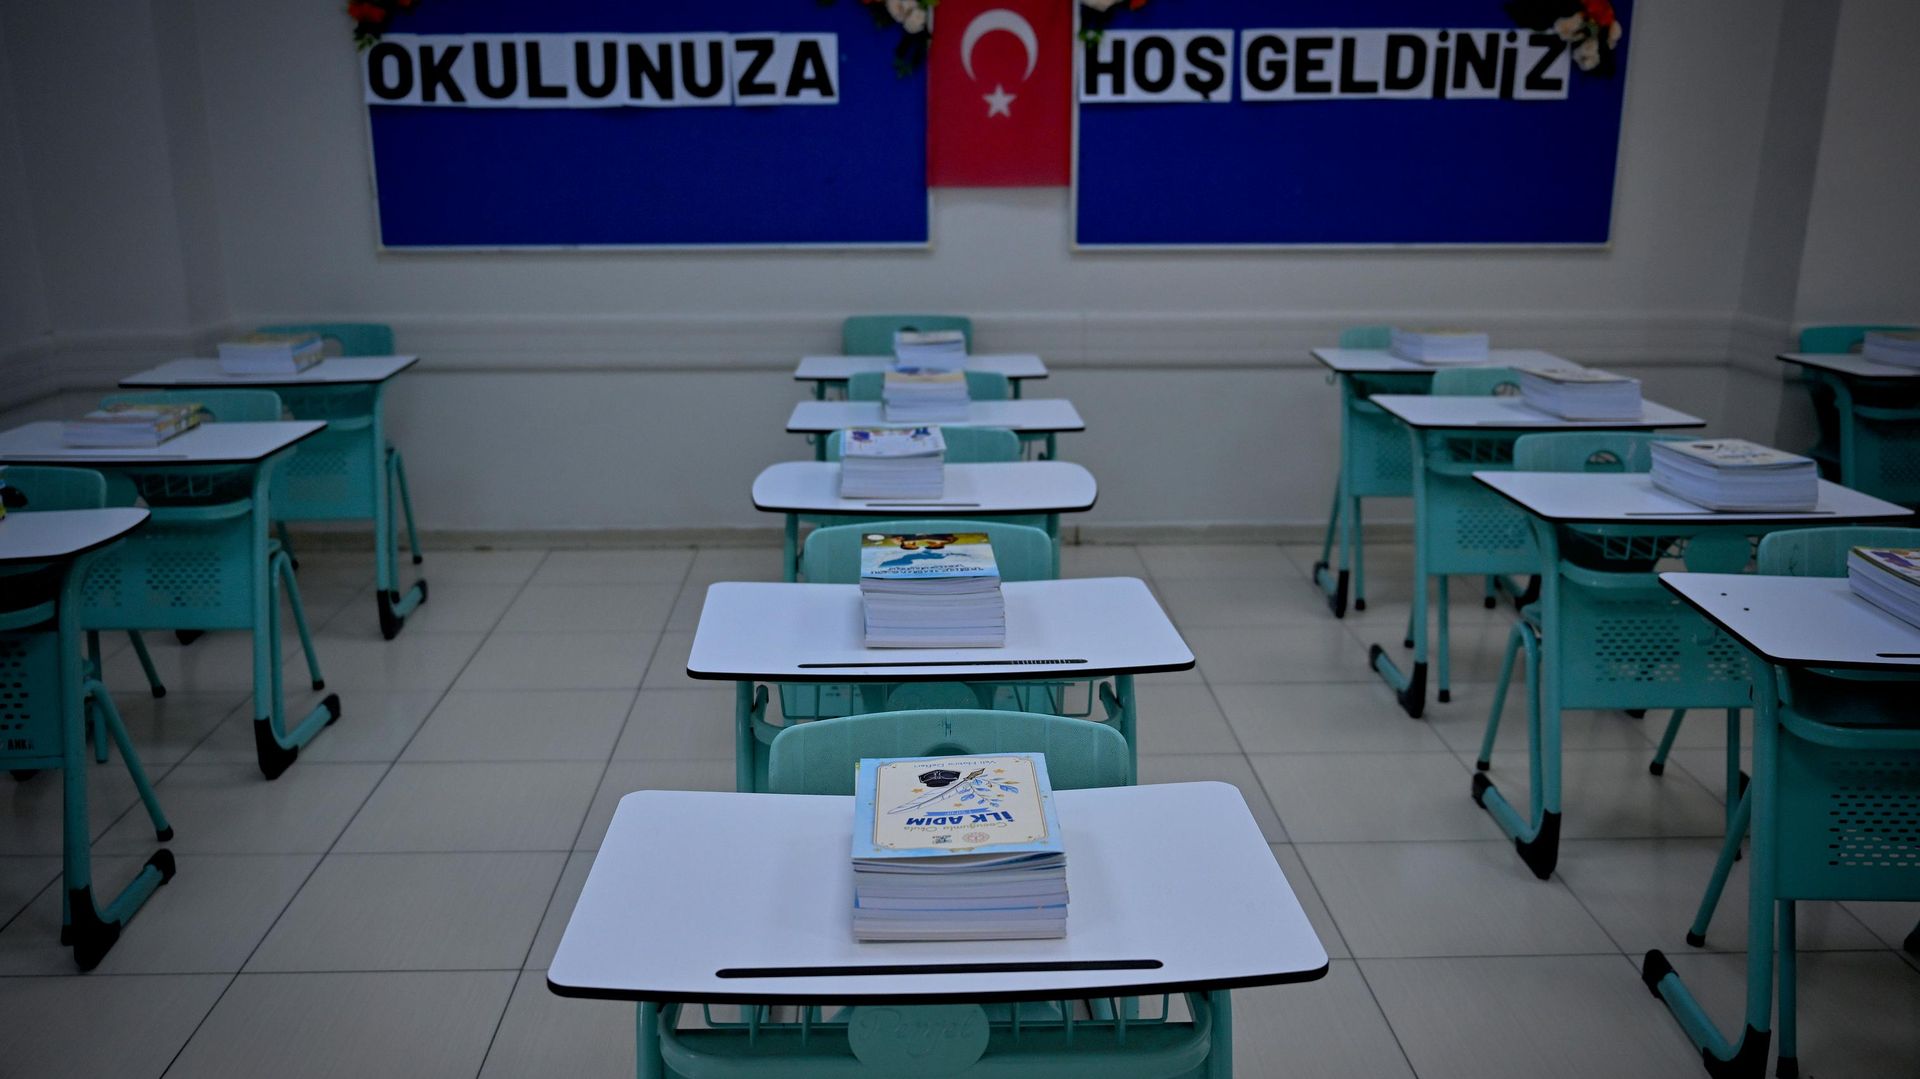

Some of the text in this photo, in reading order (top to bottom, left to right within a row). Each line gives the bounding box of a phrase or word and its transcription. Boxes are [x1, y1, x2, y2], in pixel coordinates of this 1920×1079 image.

[367, 38, 836, 103] OKULUNUZA
[1083, 35, 1227, 101] HOŞ
[906, 815, 963, 825] ADIM
[970, 811, 1014, 823] İLK
